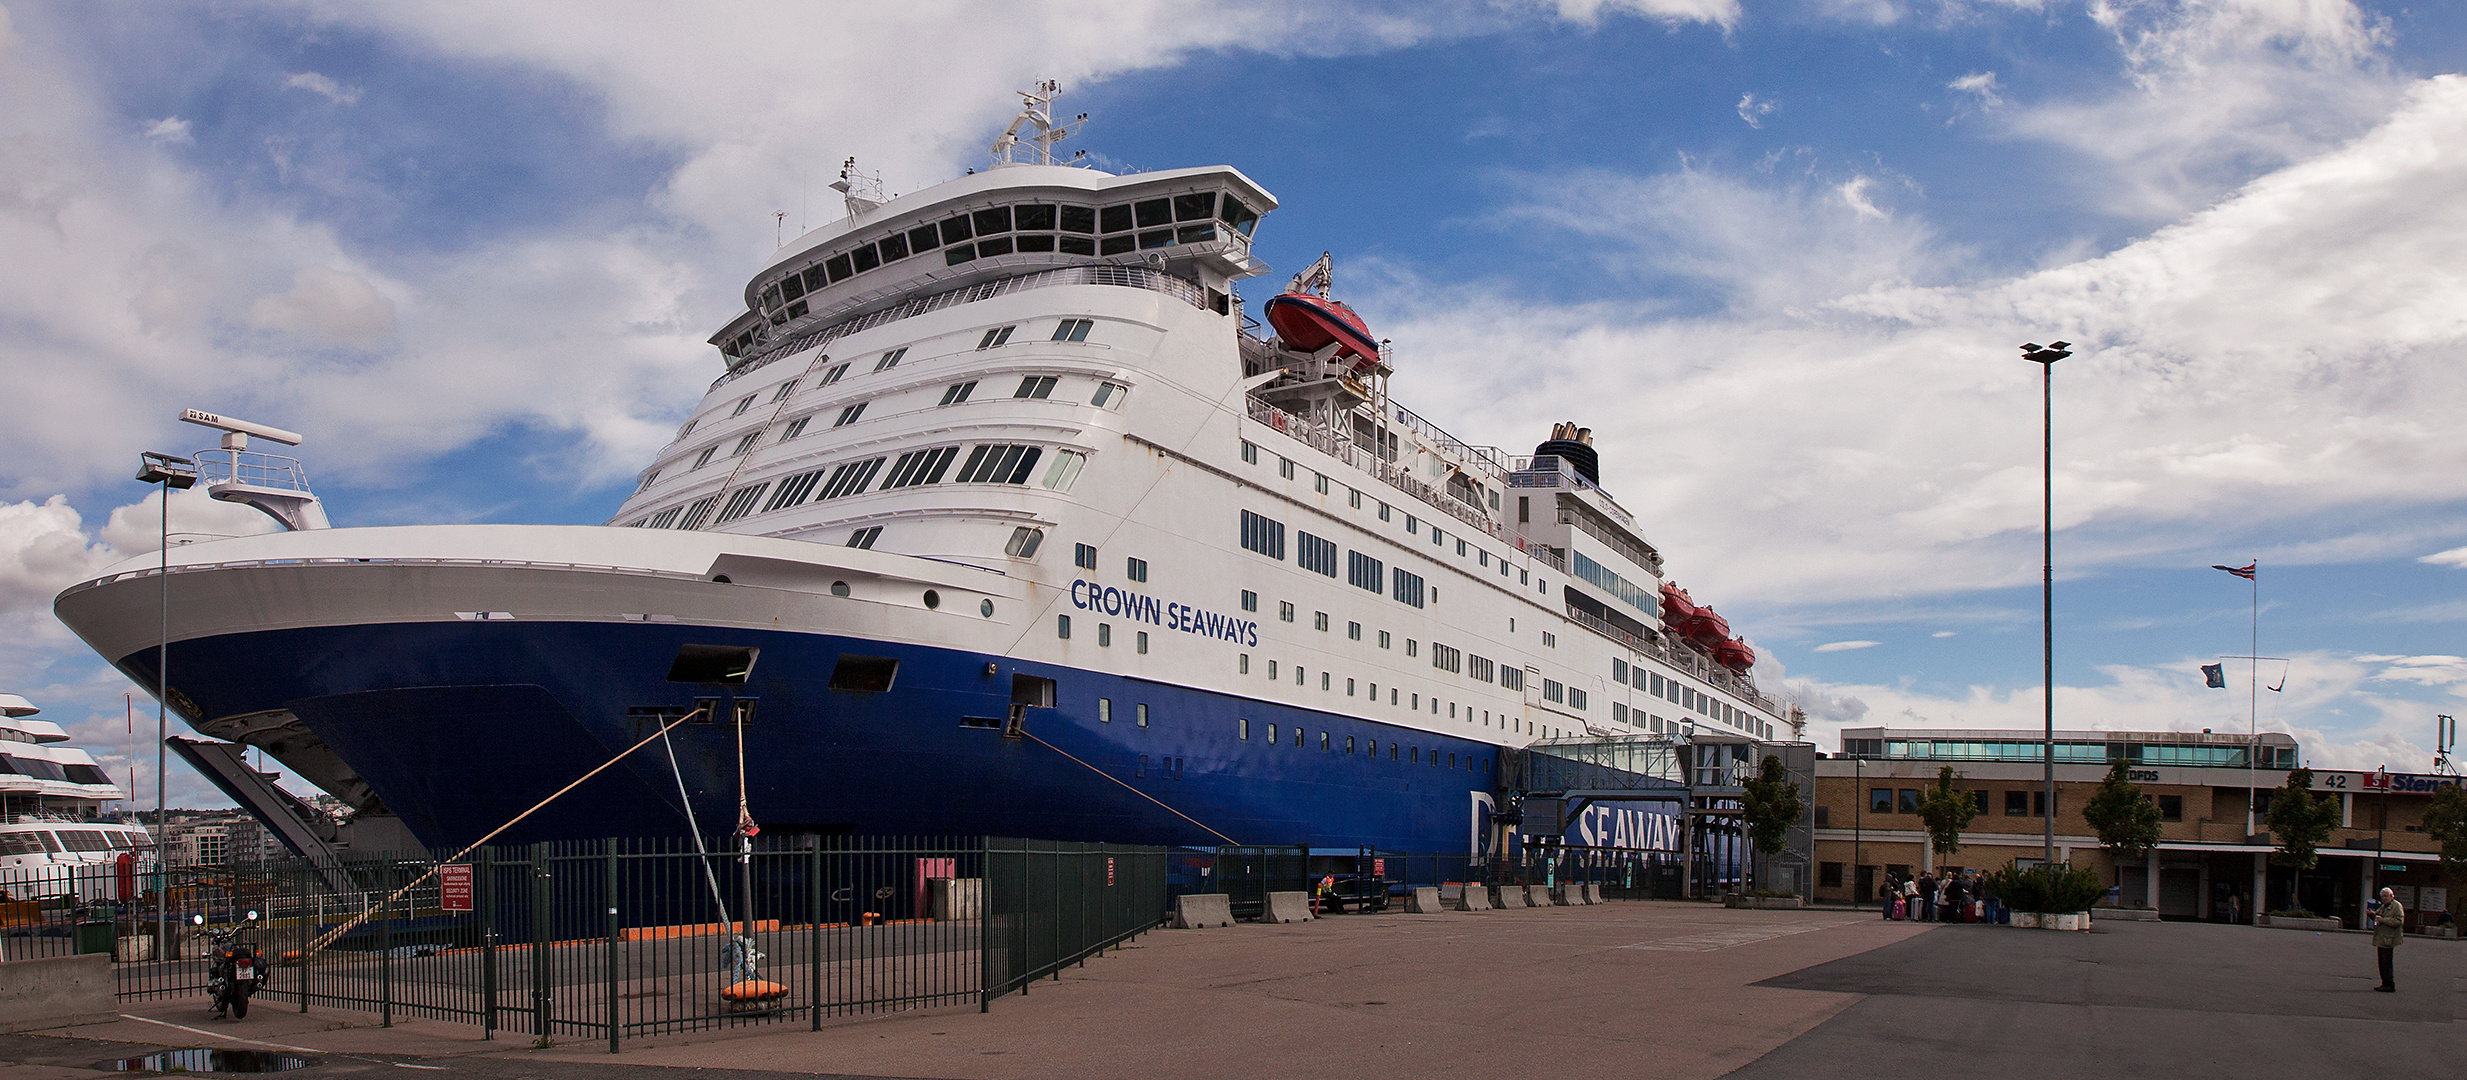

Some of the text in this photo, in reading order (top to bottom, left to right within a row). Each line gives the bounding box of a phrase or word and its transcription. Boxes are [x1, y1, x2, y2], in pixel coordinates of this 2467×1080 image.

[198, 412, 219, 424] SAM
[1071, 579, 1258, 647] CROWN SEAWAYS
[2129, 770, 2159, 781] DFDS
[2325, 775, 2347, 789] 42
[1579, 803, 1680, 869] SEAWAY
